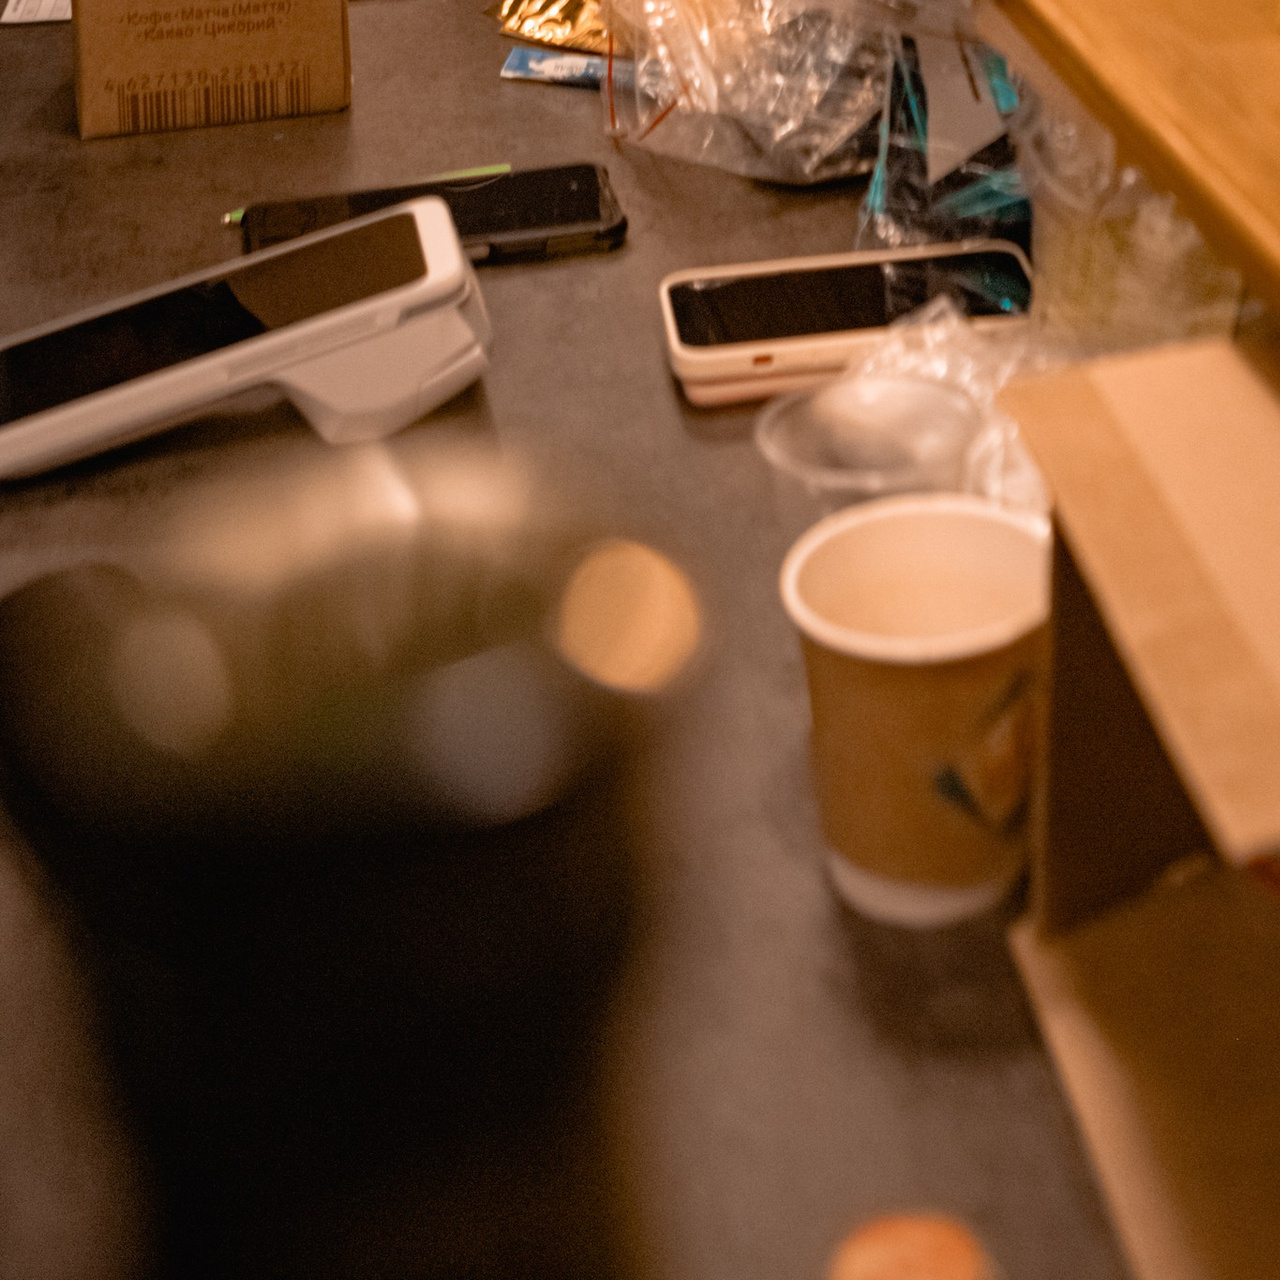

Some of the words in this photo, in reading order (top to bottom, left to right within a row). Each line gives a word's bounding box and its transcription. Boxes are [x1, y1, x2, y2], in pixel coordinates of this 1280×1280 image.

[127, 9, 172, 27] Кофе
[181, 6, 229, 22] Матча
[144, 24, 194, 41] Какао
[204, 15, 276, 39] Цикорий
